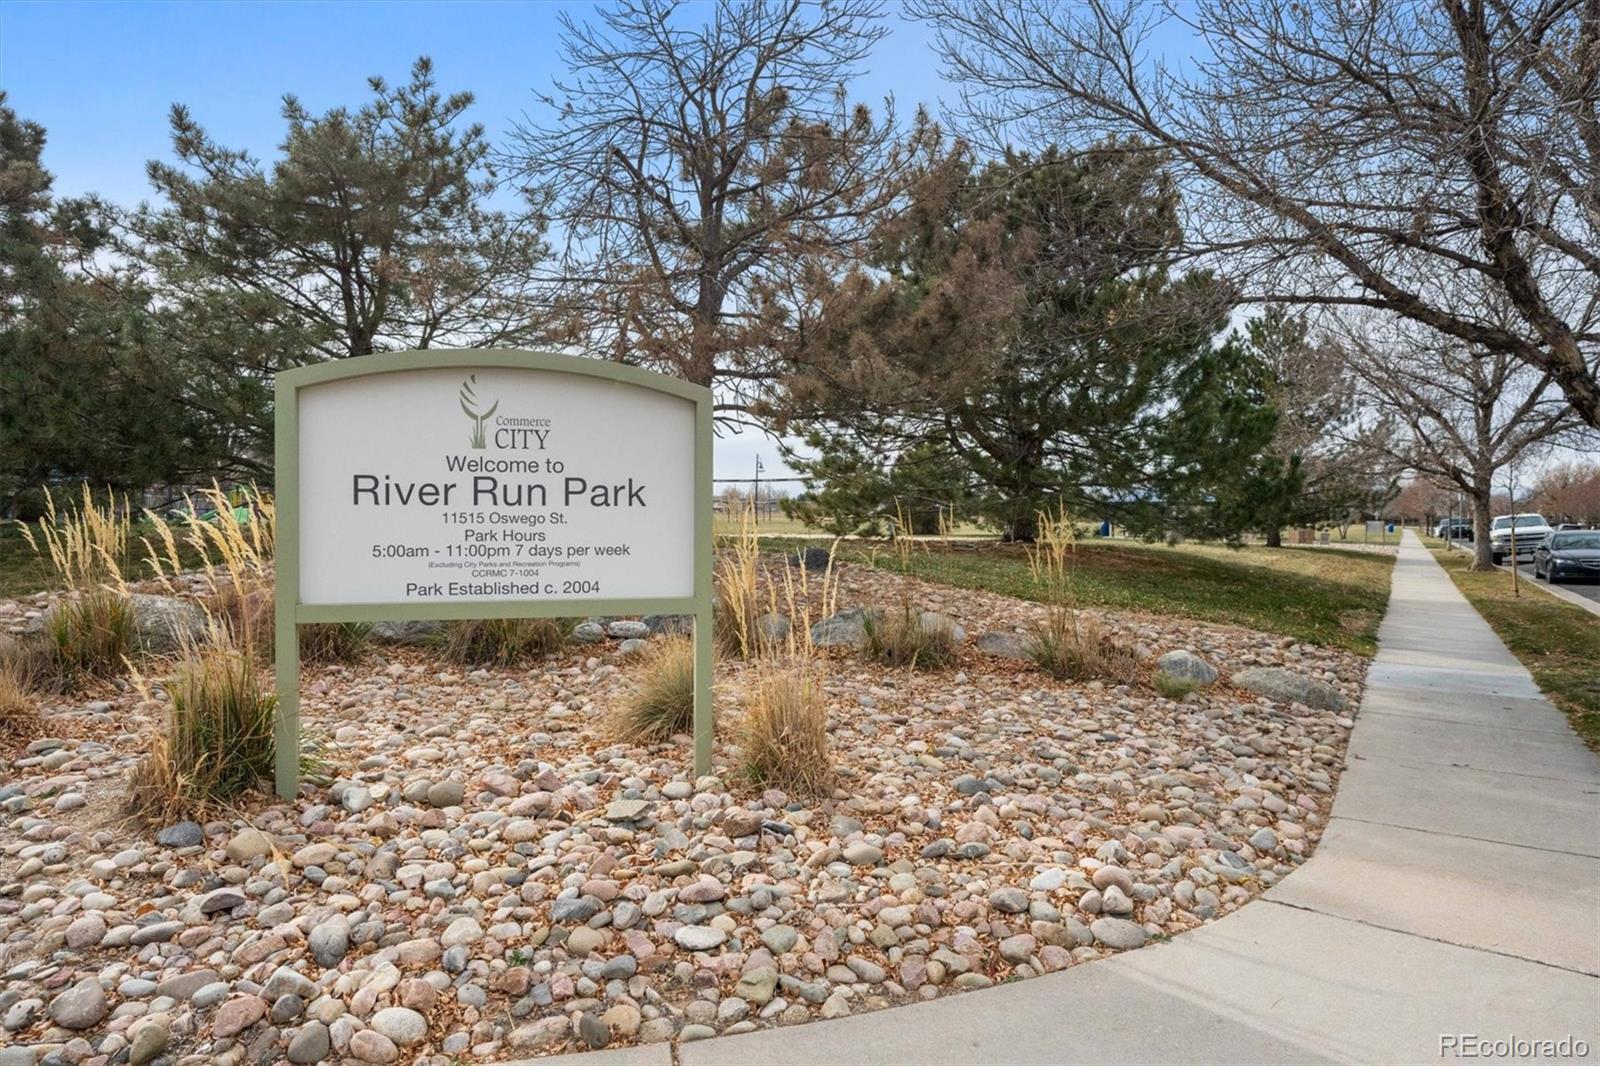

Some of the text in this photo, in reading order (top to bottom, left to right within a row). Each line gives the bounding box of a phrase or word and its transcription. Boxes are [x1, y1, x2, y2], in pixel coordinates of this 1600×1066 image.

[495, 415, 551, 427] Commerce
[494, 428, 551, 450] CITY
[445, 455, 565, 474] Welcome to
[352, 474, 647, 507] River Run Park
[442, 512, 568, 527] 11515 Oswego St.
[464, 529, 546, 542] Park Hours
[372, 544, 430, 558] 5:00am
[446, 544, 511, 559] 11:00pm
[515, 545, 525, 557] 7
[528, 544, 563, 558] days
[566, 546, 591, 557] per
[594, 545, 631, 556] week
[471, 569, 540, 577] CCRMC 7-1004
[406, 581, 601, 596] Park Established c. 2004
